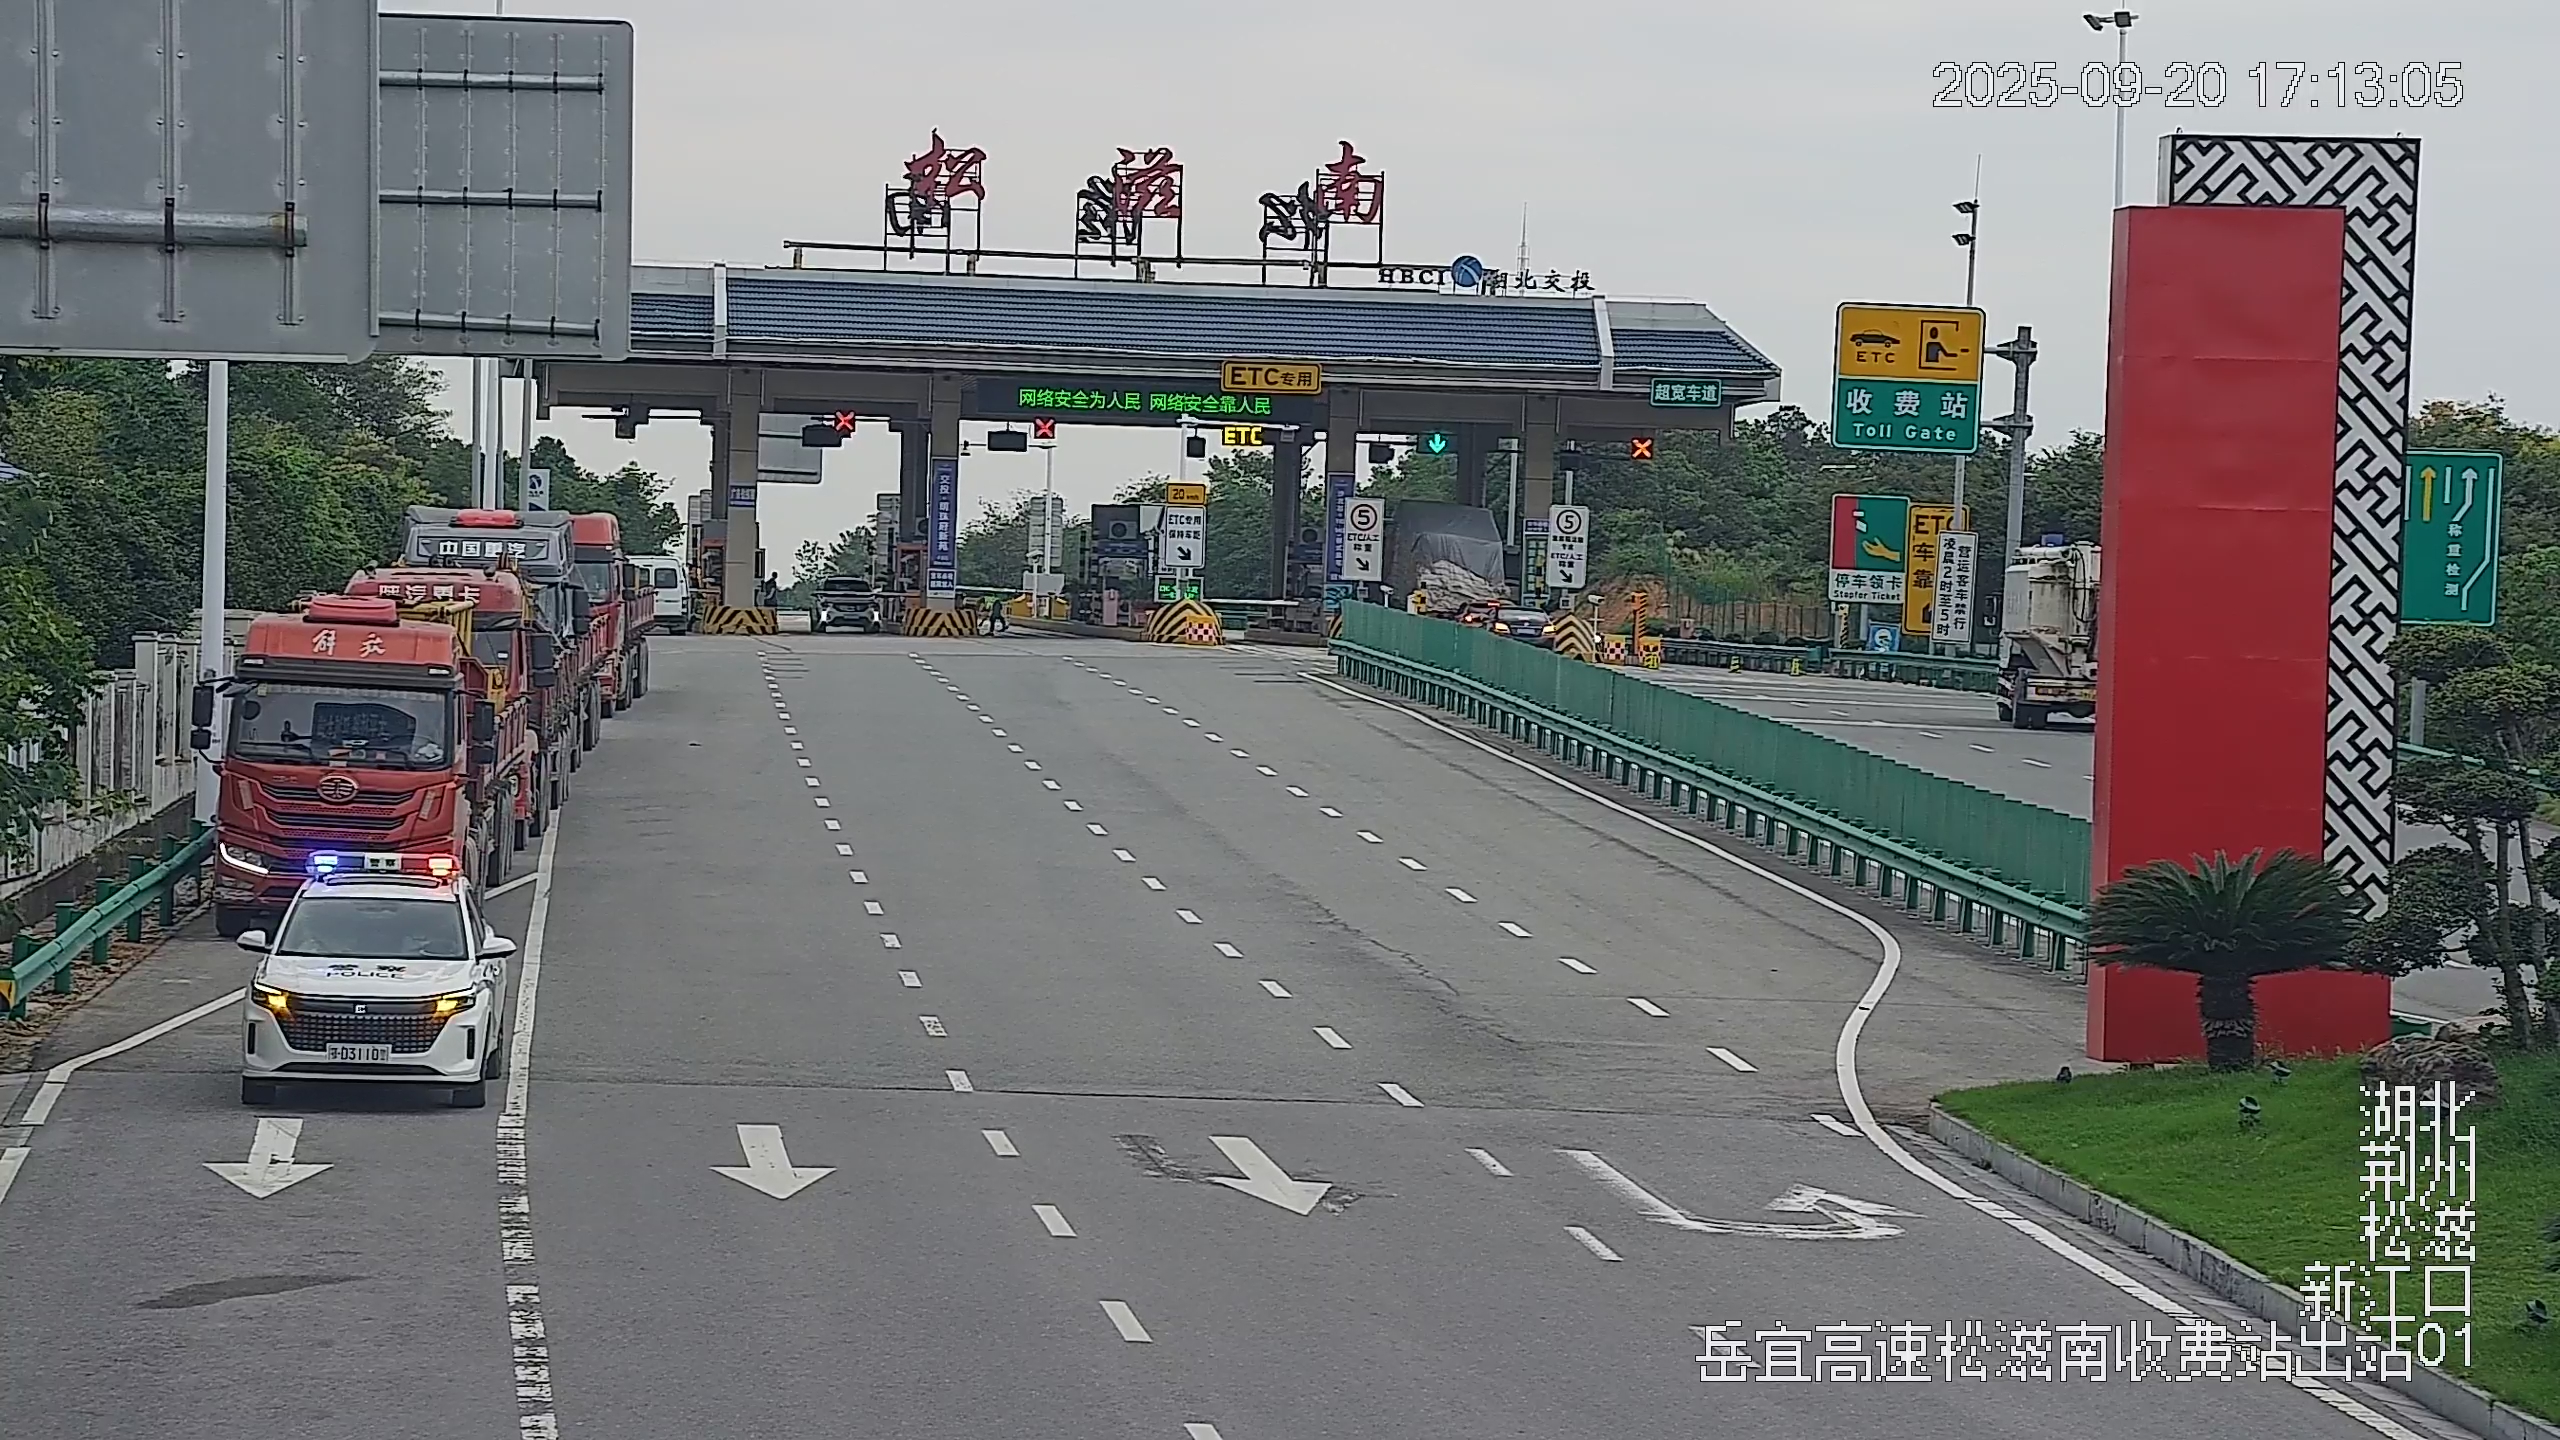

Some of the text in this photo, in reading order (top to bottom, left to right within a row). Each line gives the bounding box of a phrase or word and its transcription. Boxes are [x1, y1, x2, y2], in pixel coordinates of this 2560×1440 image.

[1856, 350, 1896, 364] ETC
[1231, 366, 1313, 388] ETC专用
[1018, 388, 1271, 416] 网络安全为人民 网络安全靠人民
[1655, 383, 1718, 402] 超宽车道
[1846, 389, 1968, 420] 收费站
[1224, 426, 1263, 445] ETC
[1852, 423, 1957, 443] Toll Gate
[1835, 573, 1904, 591] 停车领卡
[327, 971, 405, 979] POLICE
